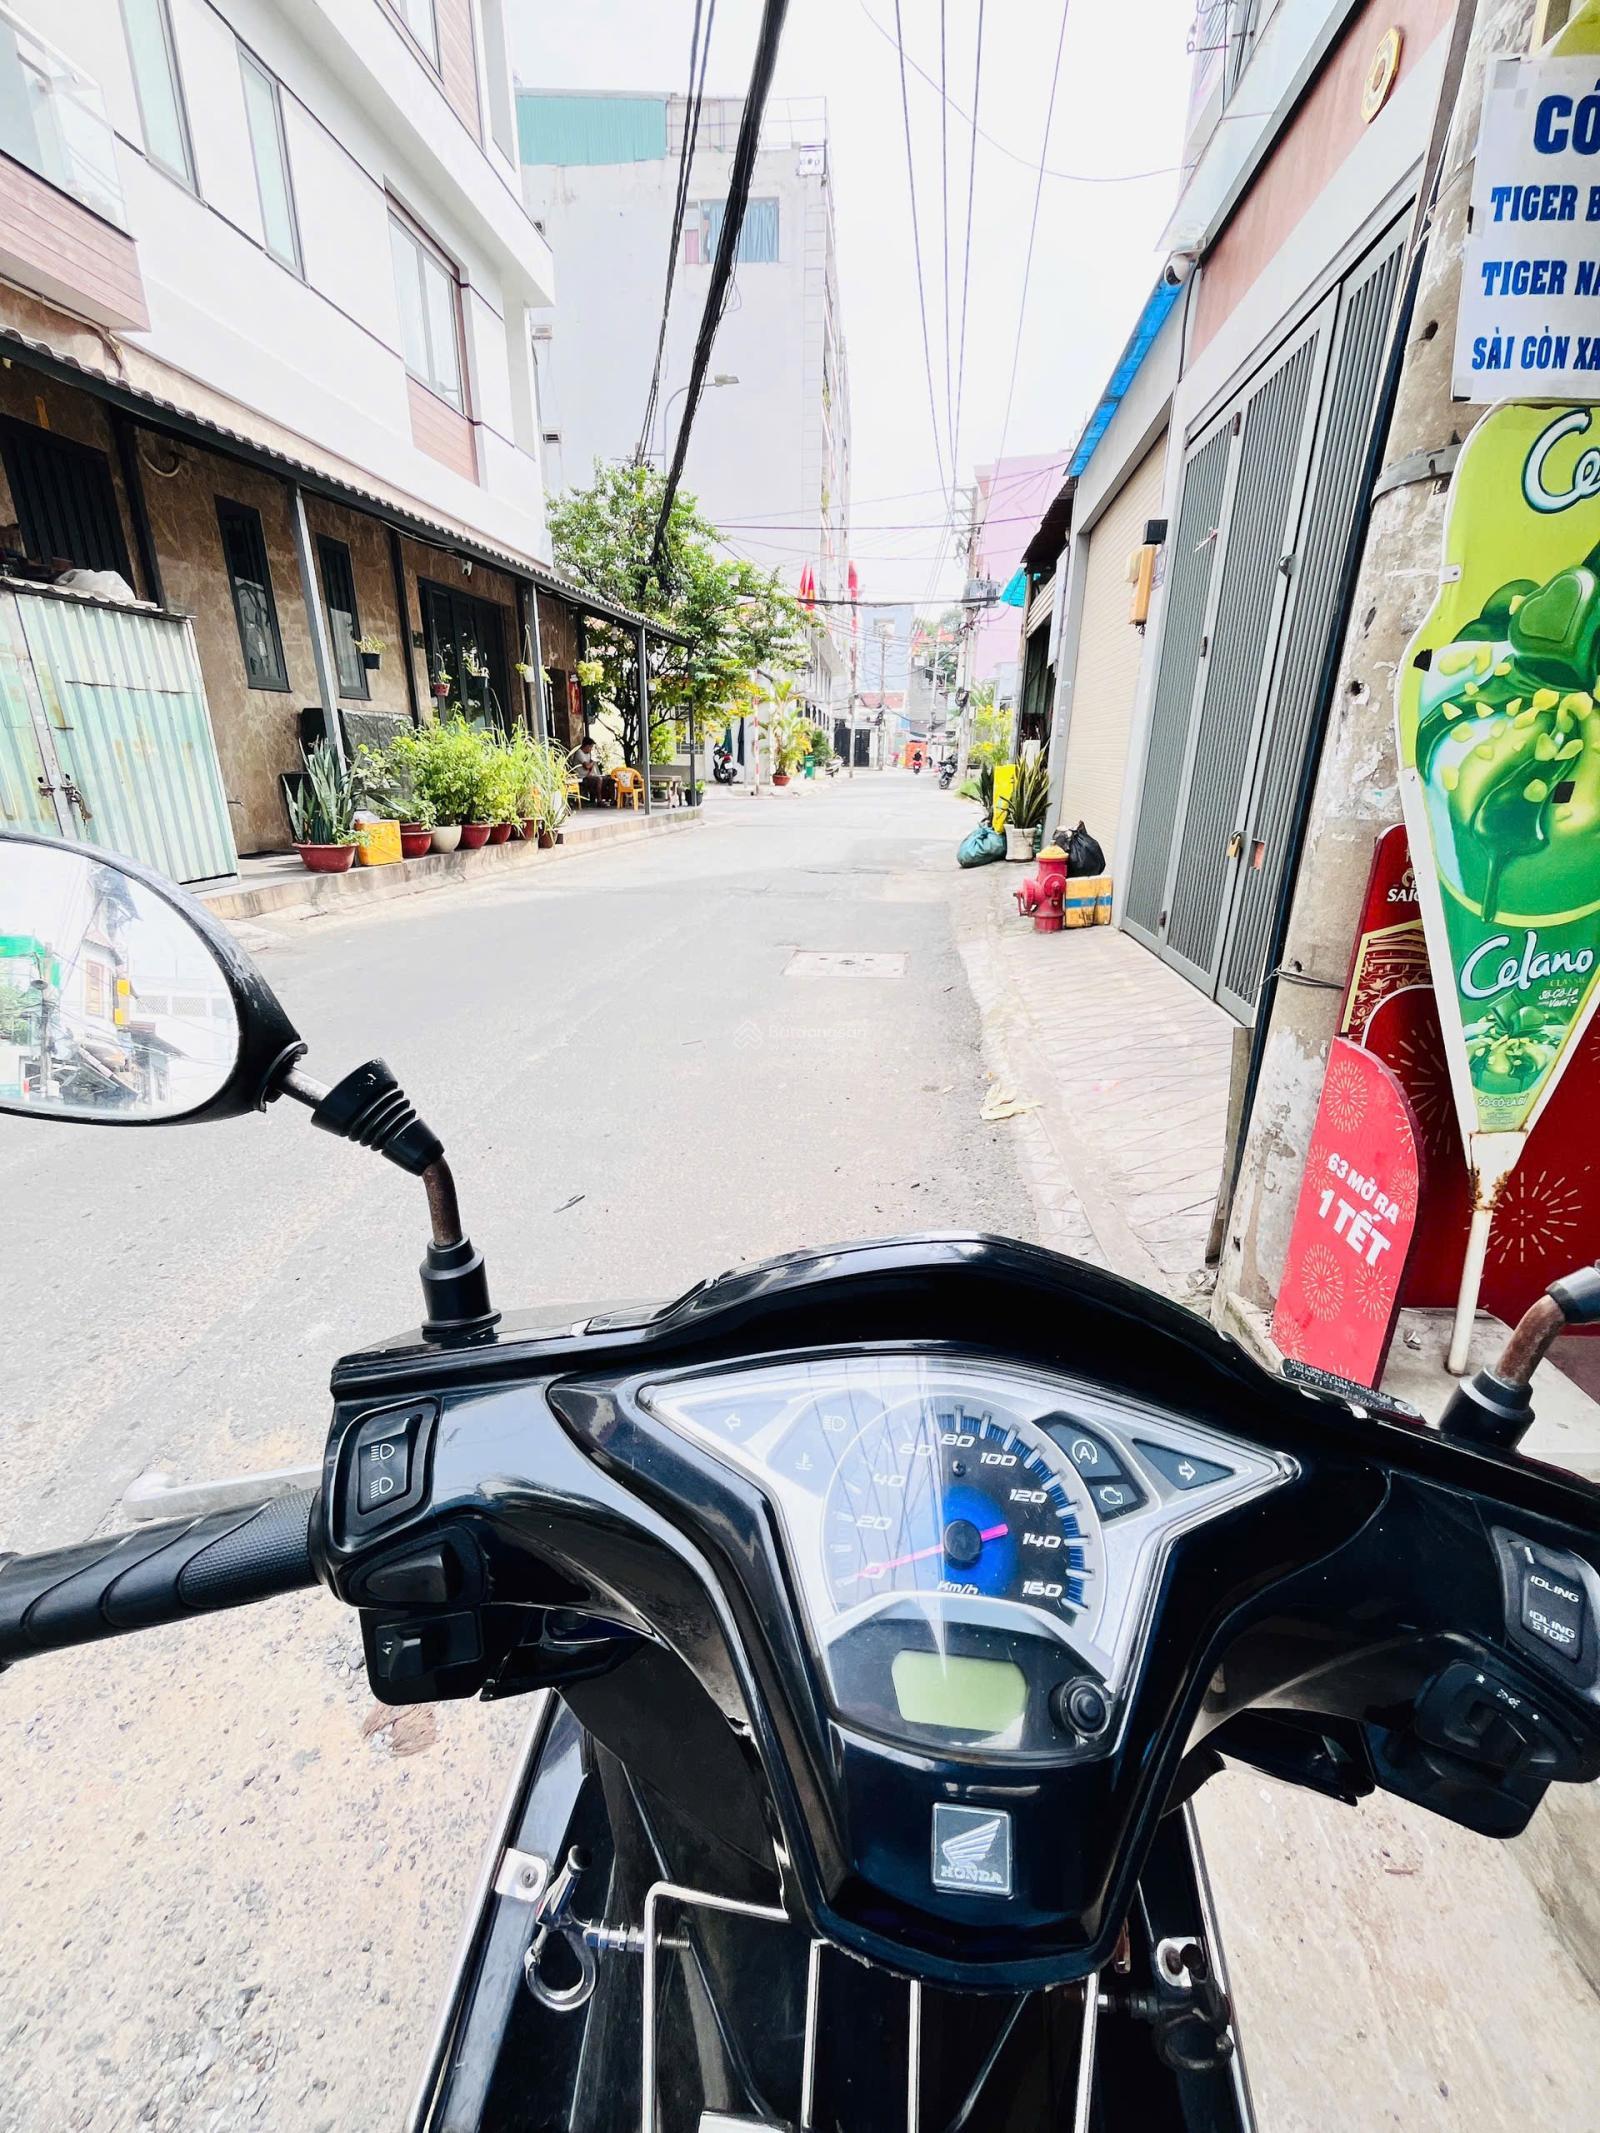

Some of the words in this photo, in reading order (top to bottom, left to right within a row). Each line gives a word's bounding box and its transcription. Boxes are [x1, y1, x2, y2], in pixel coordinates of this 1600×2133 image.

[1490, 184, 1579, 222] TIGER
[1481, 260, 1568, 297] TIGER
[1471, 326, 1515, 370] SÀI
[1520, 325, 1571, 370] GÒN
[1460, 930, 1594, 1000] Celano
[1328, 1152, 1349, 1179] 63
[1346, 1168, 1378, 1201] MỞ
[1373, 1192, 1400, 1225] RA
[1318, 1189, 1335, 1218] 1
[1333, 1198, 1392, 1267] TẾT
[899, 1443, 934, 1457] 60
[941, 1433, 976, 1448] 80
[980, 1452, 1017, 1467] 100
[873, 1475, 905, 1487] 40
[1009, 1488, 1048, 1504] 120
[856, 1515, 893, 1530] 20
[1022, 1533, 1062, 1548] 140
[937, 1580, 979, 1595] Km/h
[1022, 1581, 1063, 1597] 160
[1530, 1575, 1579, 1603] IDLING
[1529, 1610, 1576, 1639] IDLING
[1532, 1620, 1571, 1643] STOP
[941, 1864, 1003, 1884] HONDA
